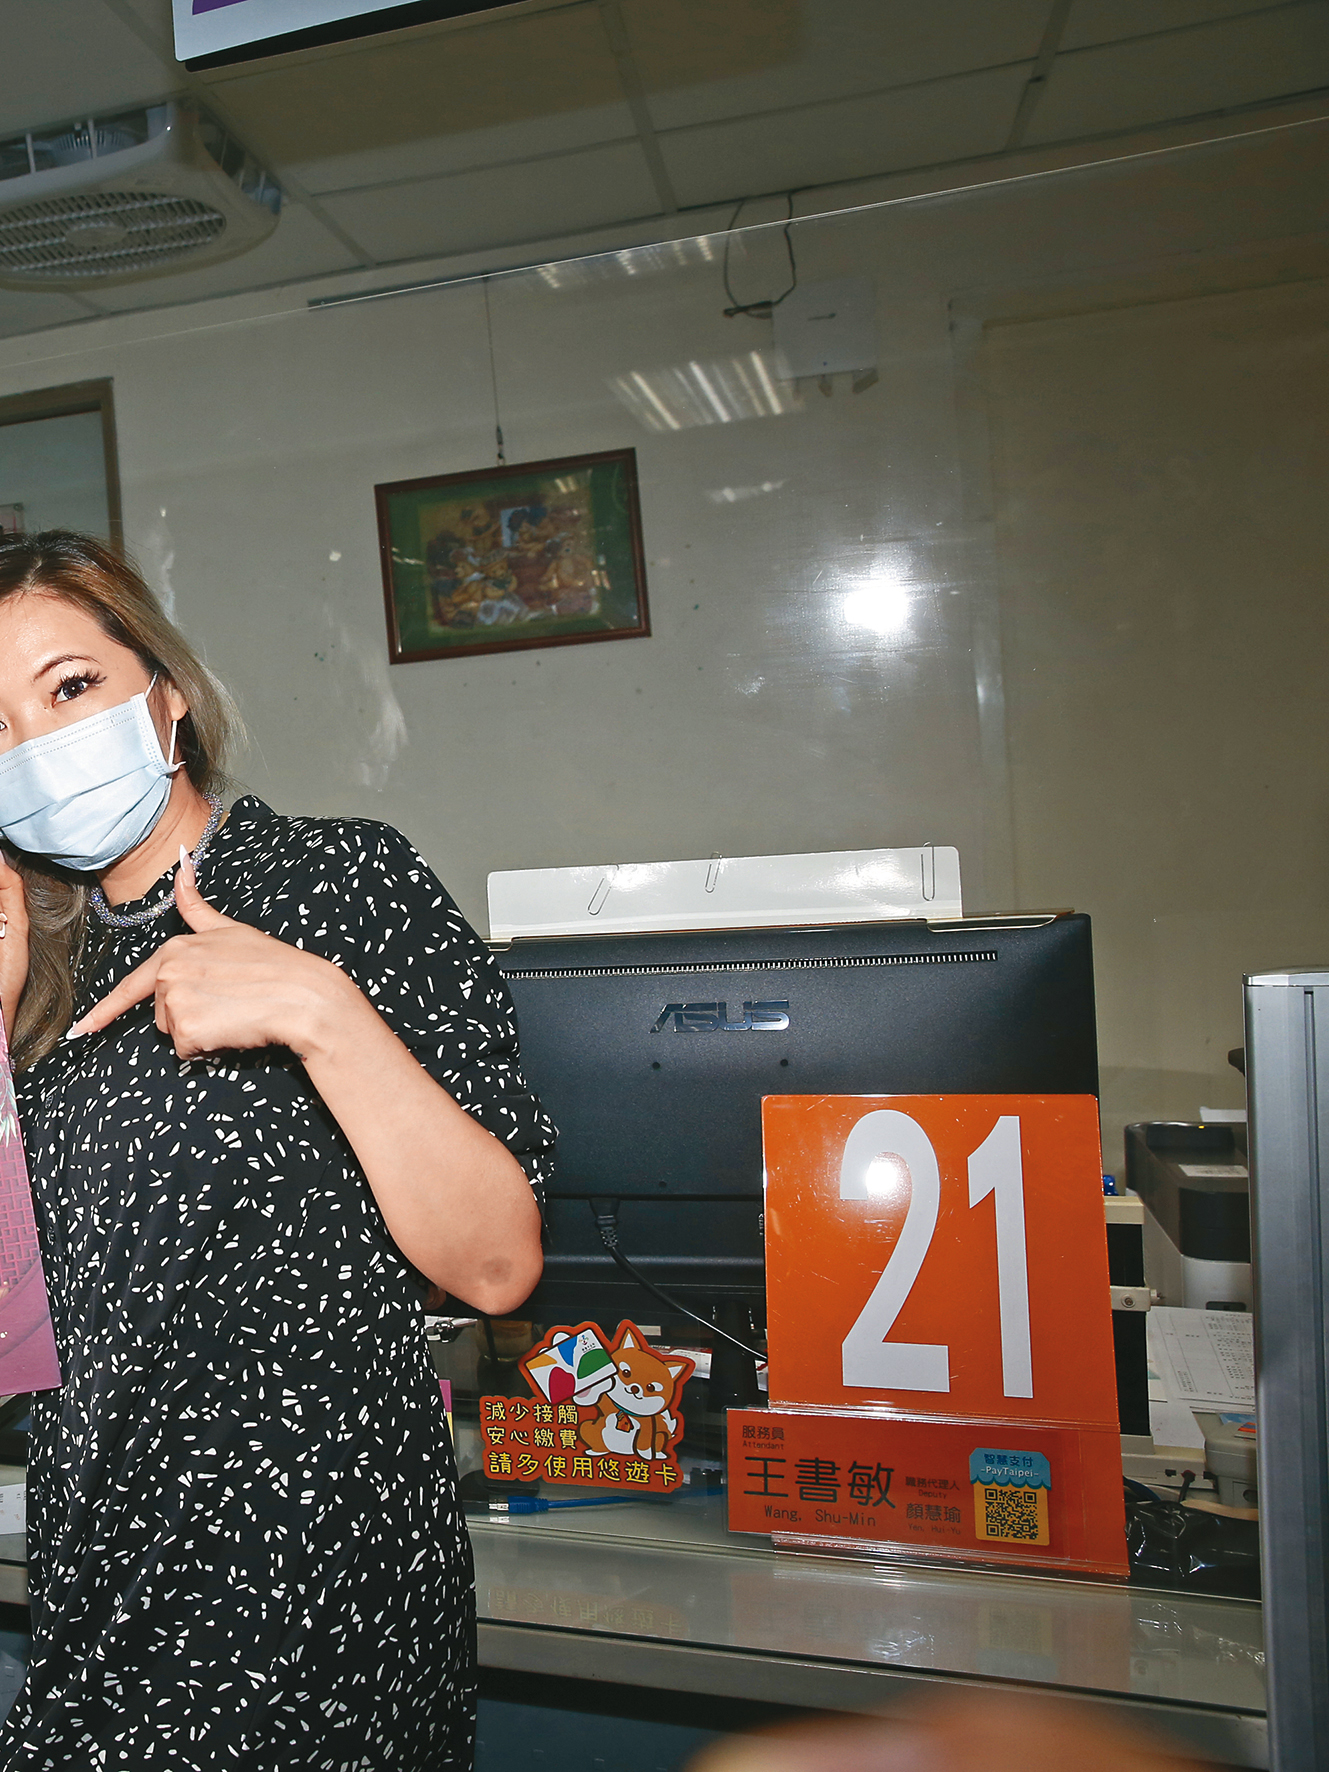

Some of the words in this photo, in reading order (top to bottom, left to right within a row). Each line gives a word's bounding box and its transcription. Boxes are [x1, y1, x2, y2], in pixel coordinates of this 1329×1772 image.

[649, 1000, 790, 1034] ASUS
[839, 1109, 1033, 1398] 21
[485, 1401, 578, 1425] 減少接觸
[486, 1425, 577, 1450] 安心繳費
[742, 1425, 785, 1441] 服務員
[742, 1440, 785, 1450] Attendant
[488, 1451, 678, 1486] 請多使用悠遊卡
[984, 1453, 1034, 1467] 智慧支付
[743, 1456, 896, 1509] 王書敏
[905, 1476, 960, 1491] 職務代理人
[918, 1489, 947, 1500] Deputy
[764, 1505, 803, 1523] Wang,
[815, 1509, 877, 1527] Shu-Min
